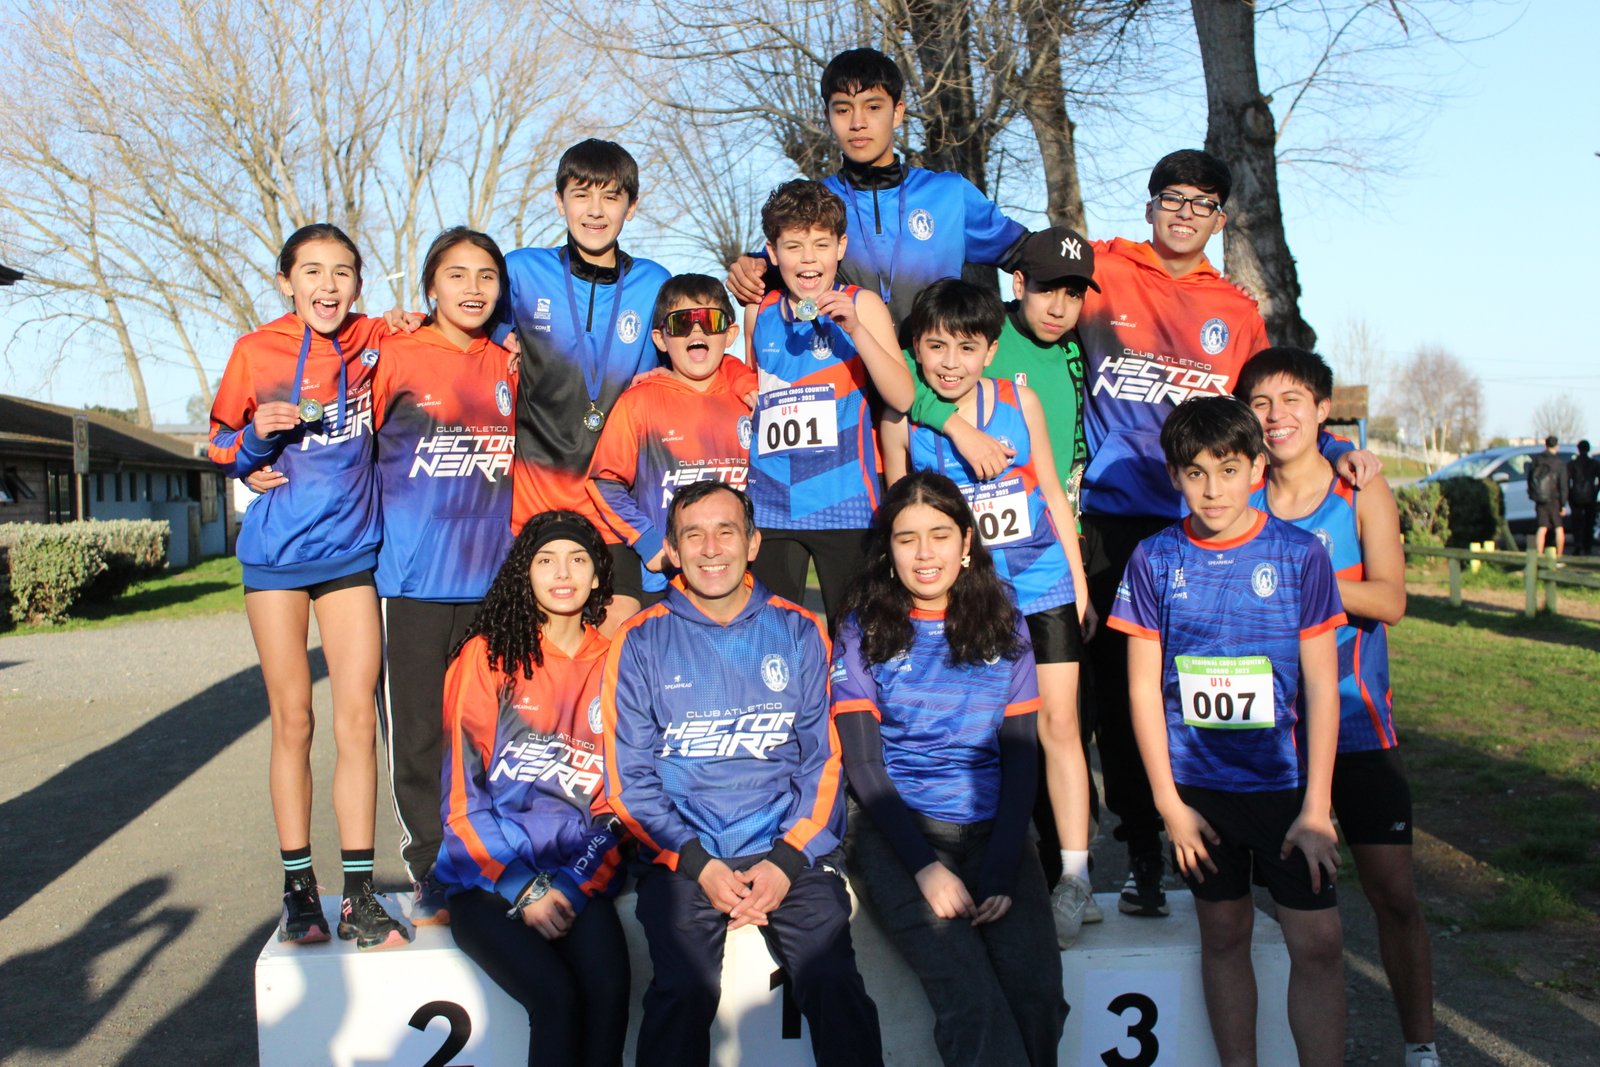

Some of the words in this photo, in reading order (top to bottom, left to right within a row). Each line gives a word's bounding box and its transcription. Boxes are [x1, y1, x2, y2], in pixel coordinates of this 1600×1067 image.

[1123, 348, 1154, 360] CLUB
[1157, 354, 1212, 370] ATLETICO
[788, 388, 804, 396] CROSS
[804, 386, 830, 394] COUNTRY
[1092, 374, 1221, 407] NEIR
[1097, 356, 1230, 398] HECTOR
[782, 405, 799, 416] U14
[414, 435, 516, 455] HECTOR
[767, 417, 823, 450] 001
[408, 454, 513, 482] NEIRA
[707, 457, 747, 466] ATLETICO
[661, 466, 749, 487] HECTO
[978, 508, 1020, 540] 02
[664, 682, 692, 690] SPEARHEAD
[1210, 677, 1231, 687] U16
[686, 710, 721, 719] CLUB
[724, 702, 783, 716] ATLETICO
[1193, 691, 1256, 721] 007
[663, 712, 796, 740] HECTOR
[499, 741, 604, 772] HECTOR
[489, 759, 602, 799] NEIRA
[769, 965, 802, 1039] 1
[407, 1000, 475, 1067] 2
[1100, 992, 1159, 1067] 3
